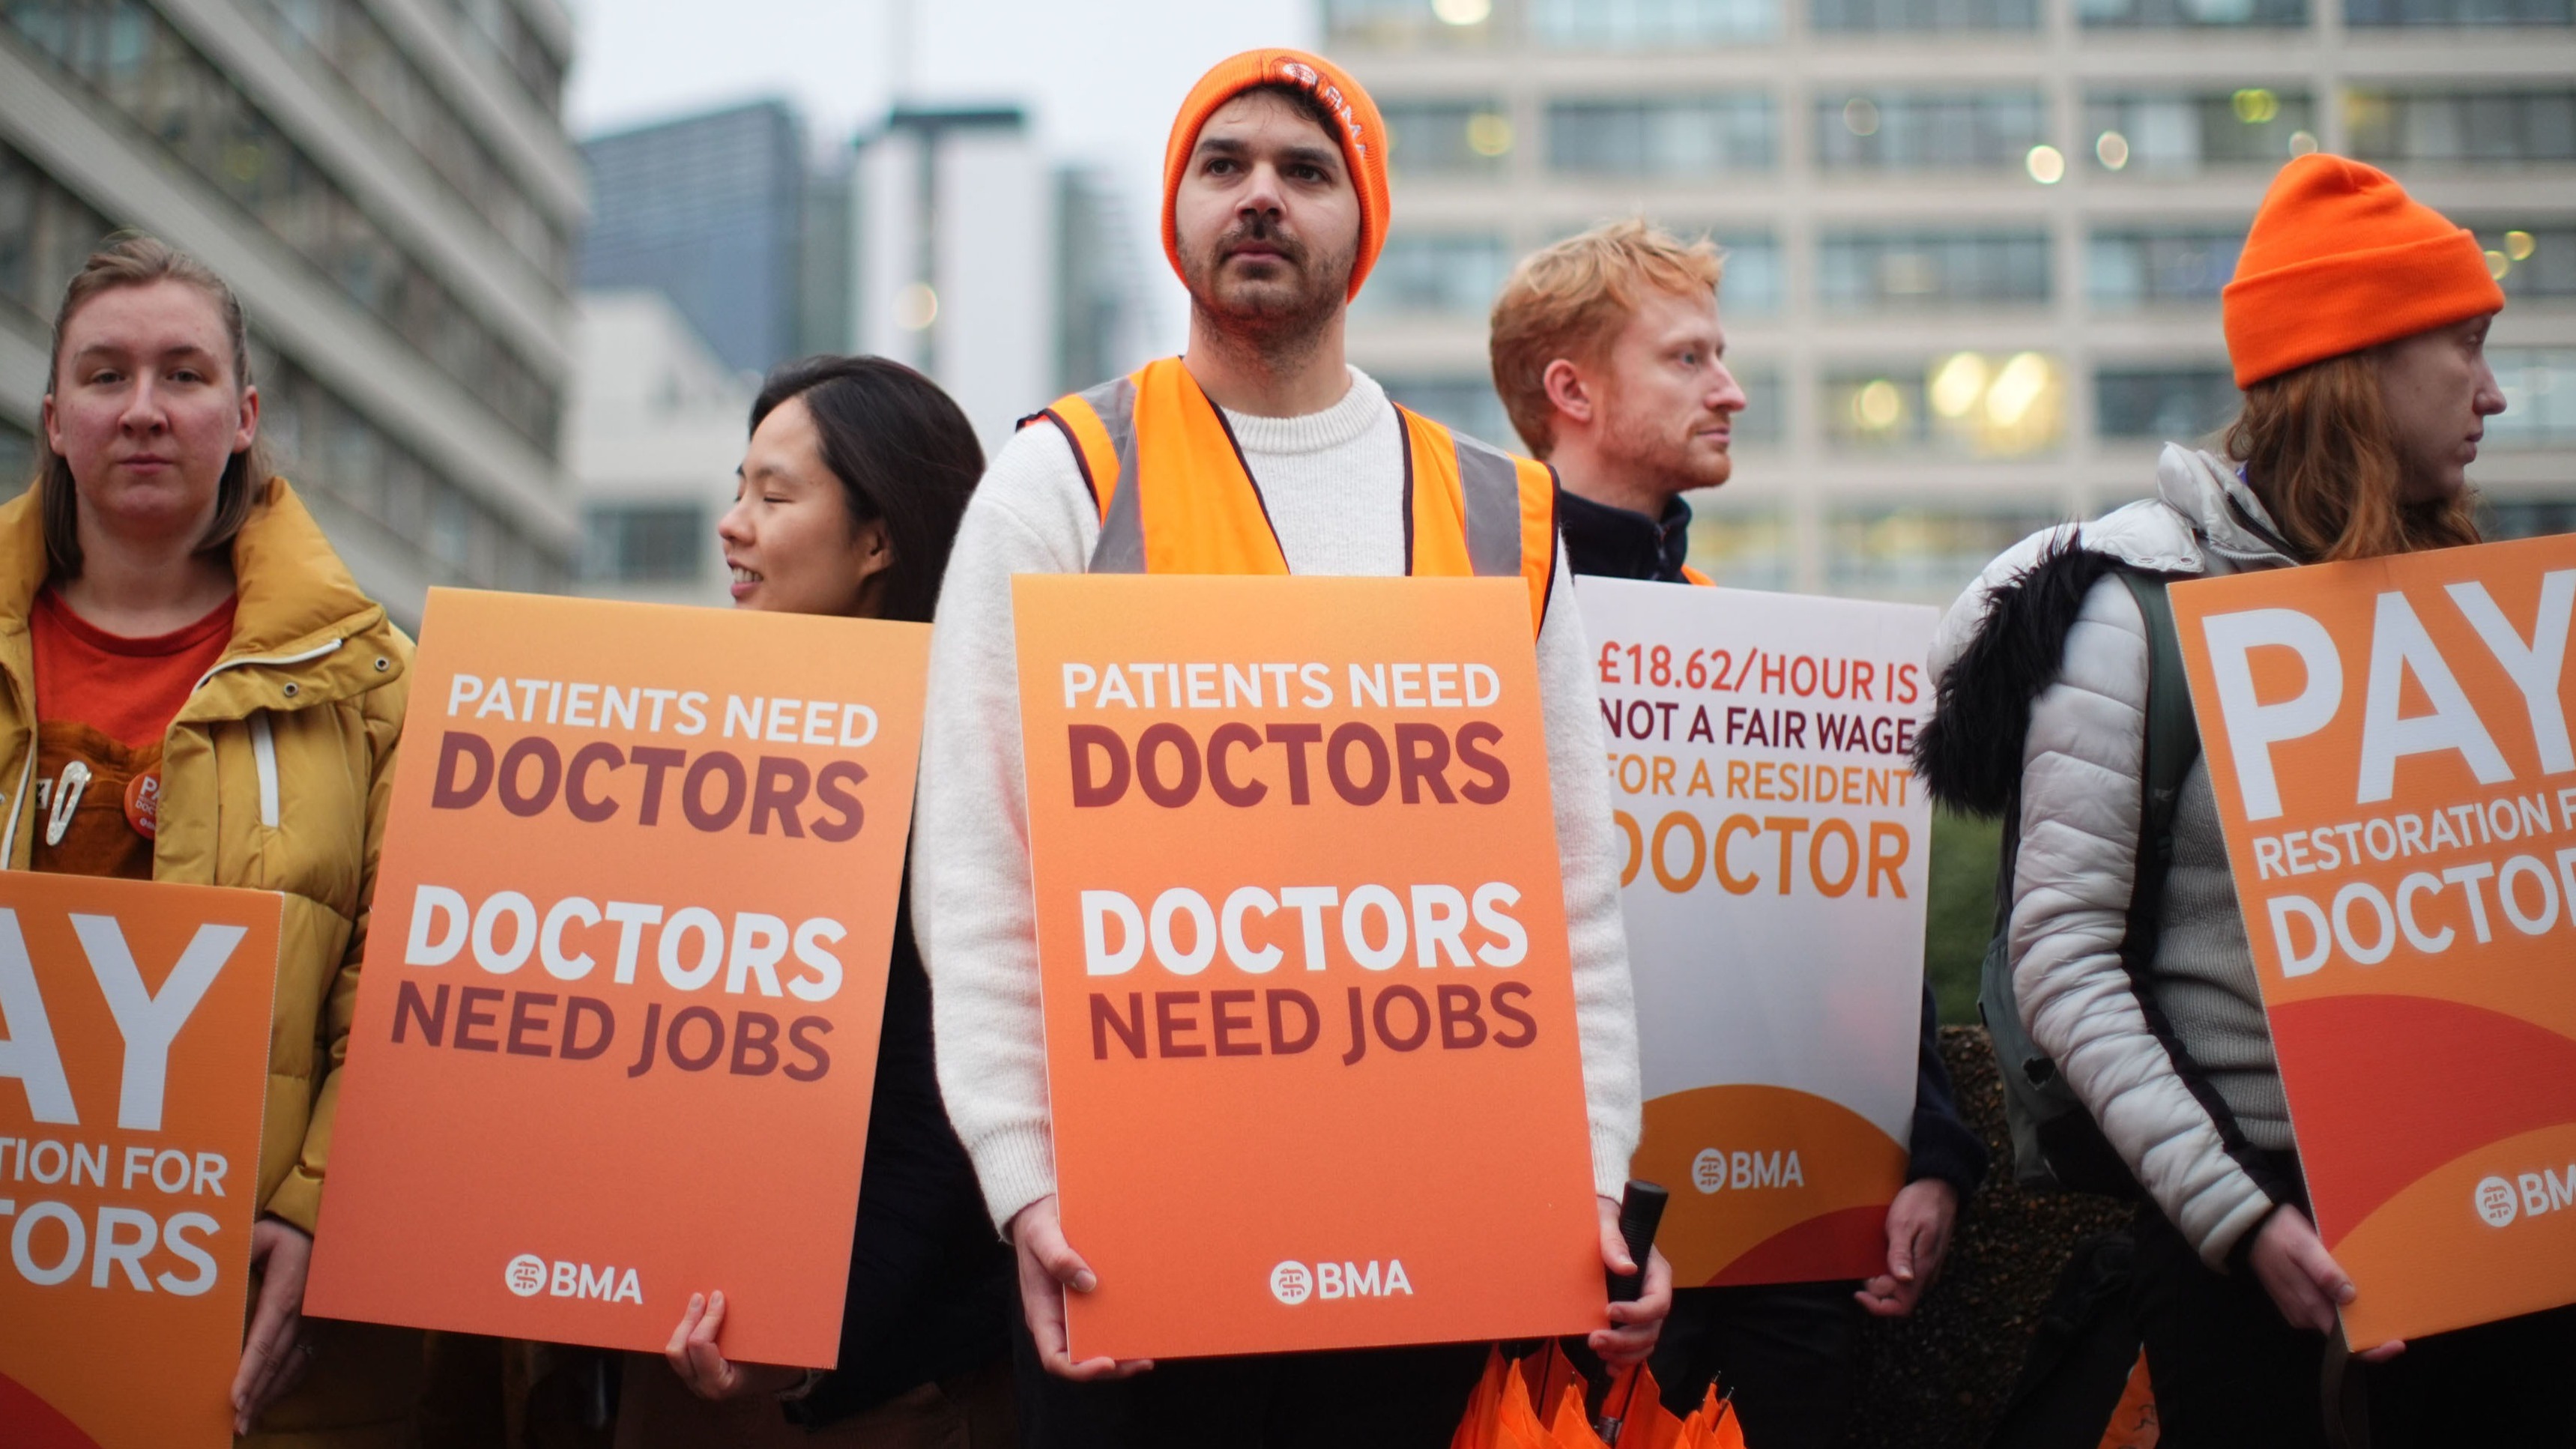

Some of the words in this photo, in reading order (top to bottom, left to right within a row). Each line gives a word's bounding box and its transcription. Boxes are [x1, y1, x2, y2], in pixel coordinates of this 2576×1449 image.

[1062, 662, 1334, 709] PATIENTS
[1349, 663, 1501, 707] NEED
[1597, 641, 1873, 701] £18.62/HOUR
[1887, 662, 1919, 704] IS
[2201, 568, 2576, 822] PAY
[447, 674, 709, 736] PATIENTS
[723, 695, 879, 748] NEED
[1599, 698, 1679, 741] NOT
[1687, 704, 1715, 744] A
[1726, 706, 1806, 750] FAIR
[1816, 713, 1917, 756] WAGE
[431, 730, 869, 843] DOCTORS
[1068, 721, 1511, 808] DOCTORS
[1687, 758, 1715, 798] A
[1726, 760, 1915, 808] RESIDENT
[2253, 792, 2553, 880] RESTORATION
[404, 884, 848, 1002] DOCTORS
[1080, 881, 1529, 976] DOCTORS
[390, 979, 615, 1062] NEED
[626, 1002, 835, 1083] JOBS
[1089, 987, 1321, 1060] NEED
[1341, 981, 1538, 1067] JOBS
[122, 1147, 228, 1197] FOR
[1731, 1150, 1805, 1190] BMA
[550, 1260, 643, 1305] BMA
[1316, 1258, 1414, 1299] BMA
